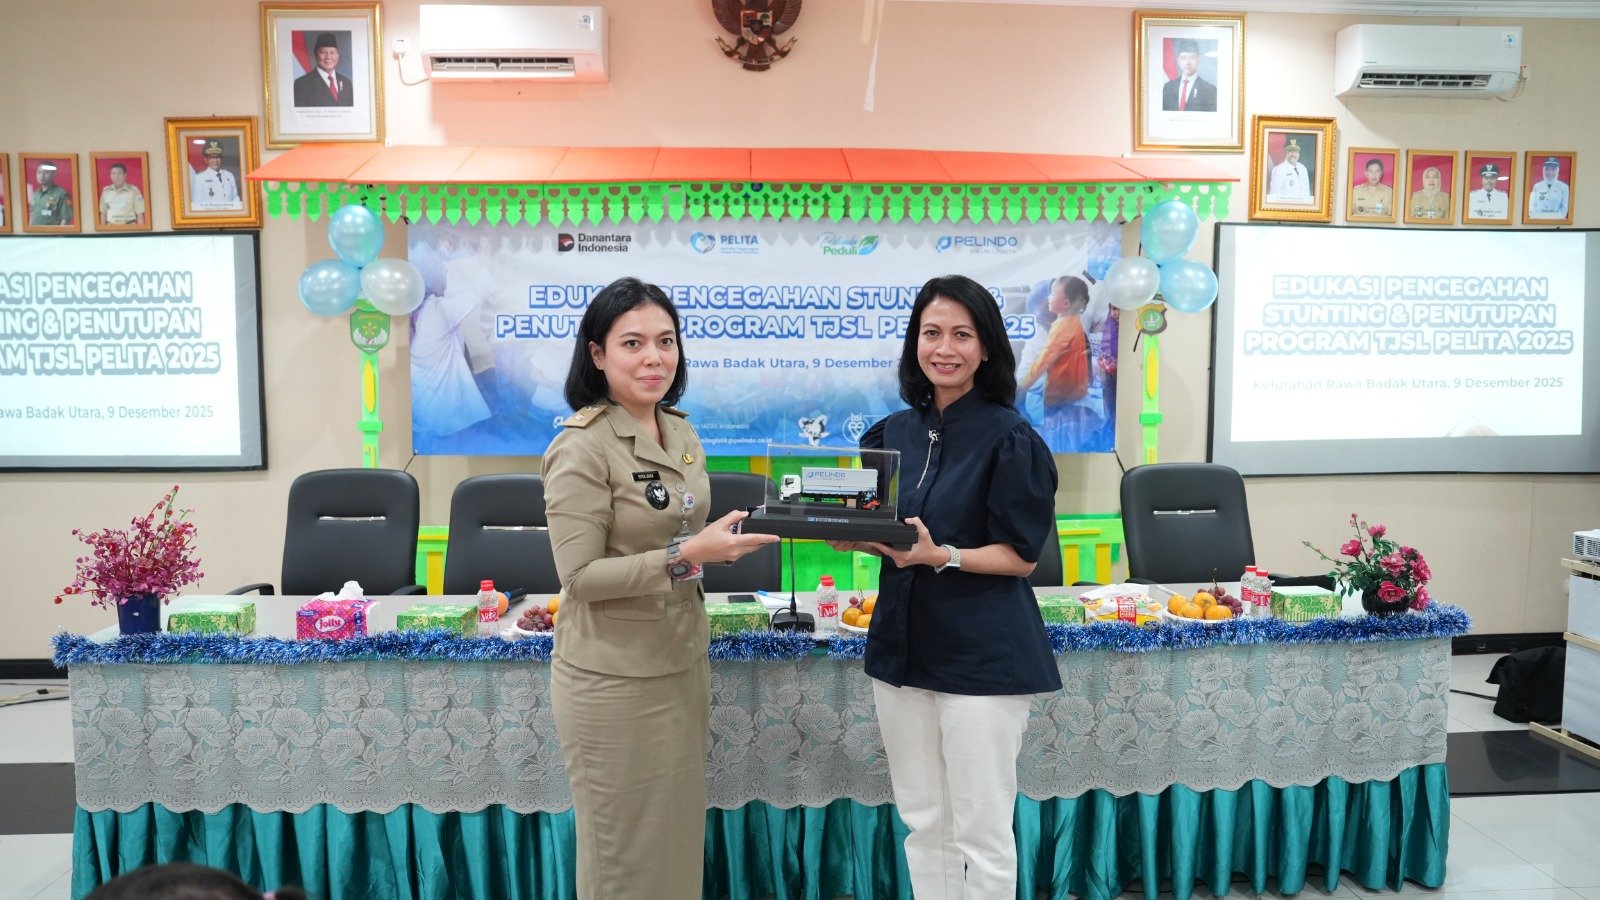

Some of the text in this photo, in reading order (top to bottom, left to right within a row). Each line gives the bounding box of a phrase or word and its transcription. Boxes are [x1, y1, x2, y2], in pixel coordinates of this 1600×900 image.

[578, 233, 632, 242] Danantara
[720, 235, 759, 245] PELITA
[954, 236, 1018, 247] PELINDO
[578, 243, 628, 252] Indonesia
[823, 246, 858, 255] Peduli
[35, 270, 194, 304] PENCEGAHAN
[1273, 275, 1549, 301] EDUKASI PENCEGAHAN
[847, 286, 922, 310] STUN
[1262, 303, 1556, 328] STUNTING & PENUTUPAN
[42, 308, 61, 340] &
[64, 307, 202, 340] PENUTUPAN
[811, 315, 873, 339] TJSL
[1243, 331, 1574, 355] PROGRAM TJSL PELITA 2025
[28, 343, 84, 376] TJSL
[85, 343, 165, 375] PELITA
[166, 342, 221, 374] 2025
[723, 357, 766, 368] Badak
[770, 358, 809, 369] Utara,
[813, 358, 820, 368] 9
[825, 358, 892, 368] Desember
[1253, 377, 1563, 390] Kelurahan Rawa Badak Utara, 9 Desember 2025
[26, 406, 64, 418] Badak
[69, 406, 104, 420] Utara,
[108, 406, 115, 418] 9
[119, 405, 181, 418] Desember
[185, 405, 213, 418] 2025
[319, 619, 341, 629] jolly
